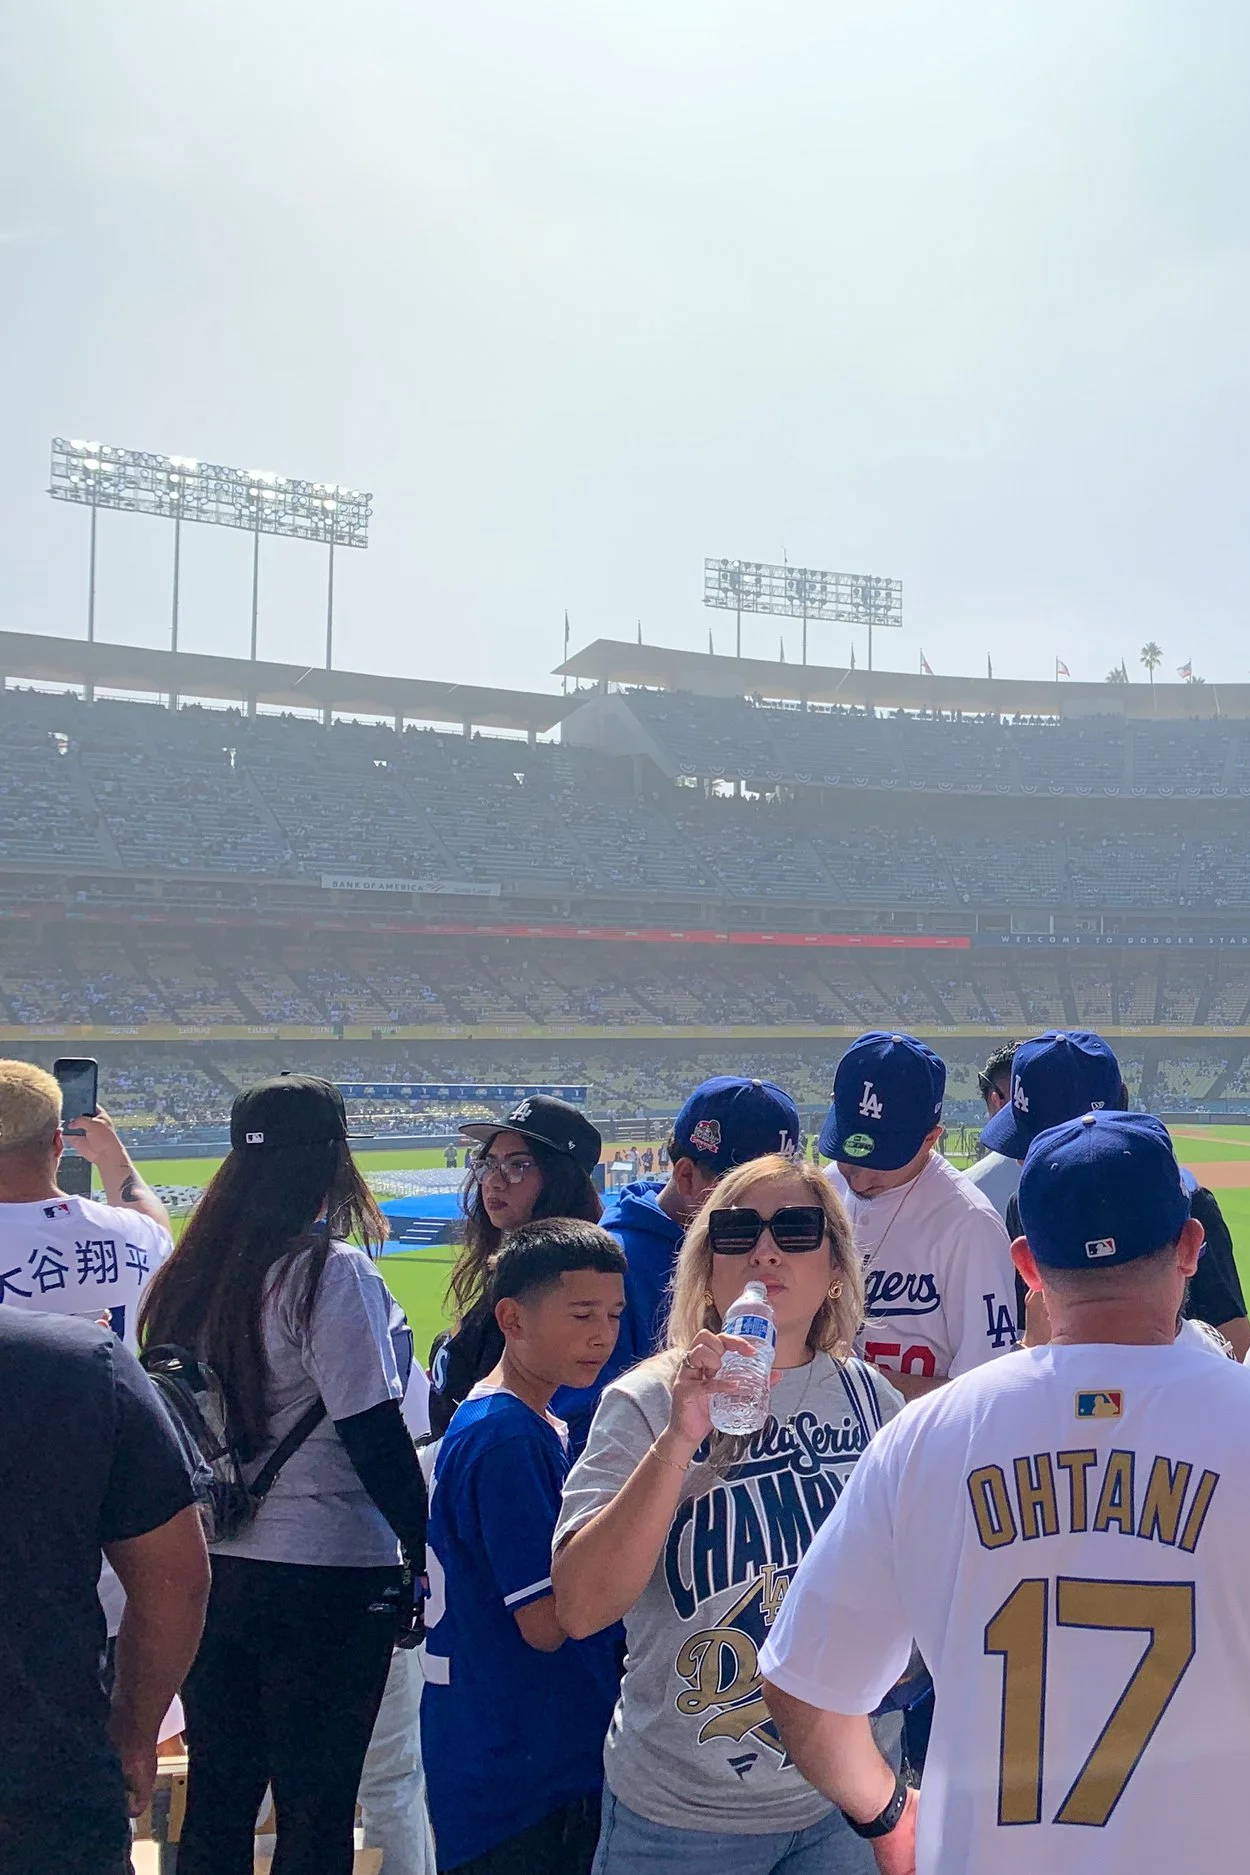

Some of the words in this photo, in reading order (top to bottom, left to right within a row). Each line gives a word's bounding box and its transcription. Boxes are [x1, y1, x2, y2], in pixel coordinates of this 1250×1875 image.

[332, 880, 361, 889] BANK
[363, 882, 376, 890] OF
[378, 883, 424, 892] AMERICA
[1001, 935, 1081, 944] WELCOME
[1095, 936, 1113, 944] TO
[1128, 936, 1194, 945] DODGER
[859, 1080, 883, 1120] LA
[983, 1293, 1018, 1349] LA
[966, 1448, 1221, 1555] OHTANI
[664, 1467, 851, 1621] CHAMP
[983, 1575, 1197, 1828] 17
